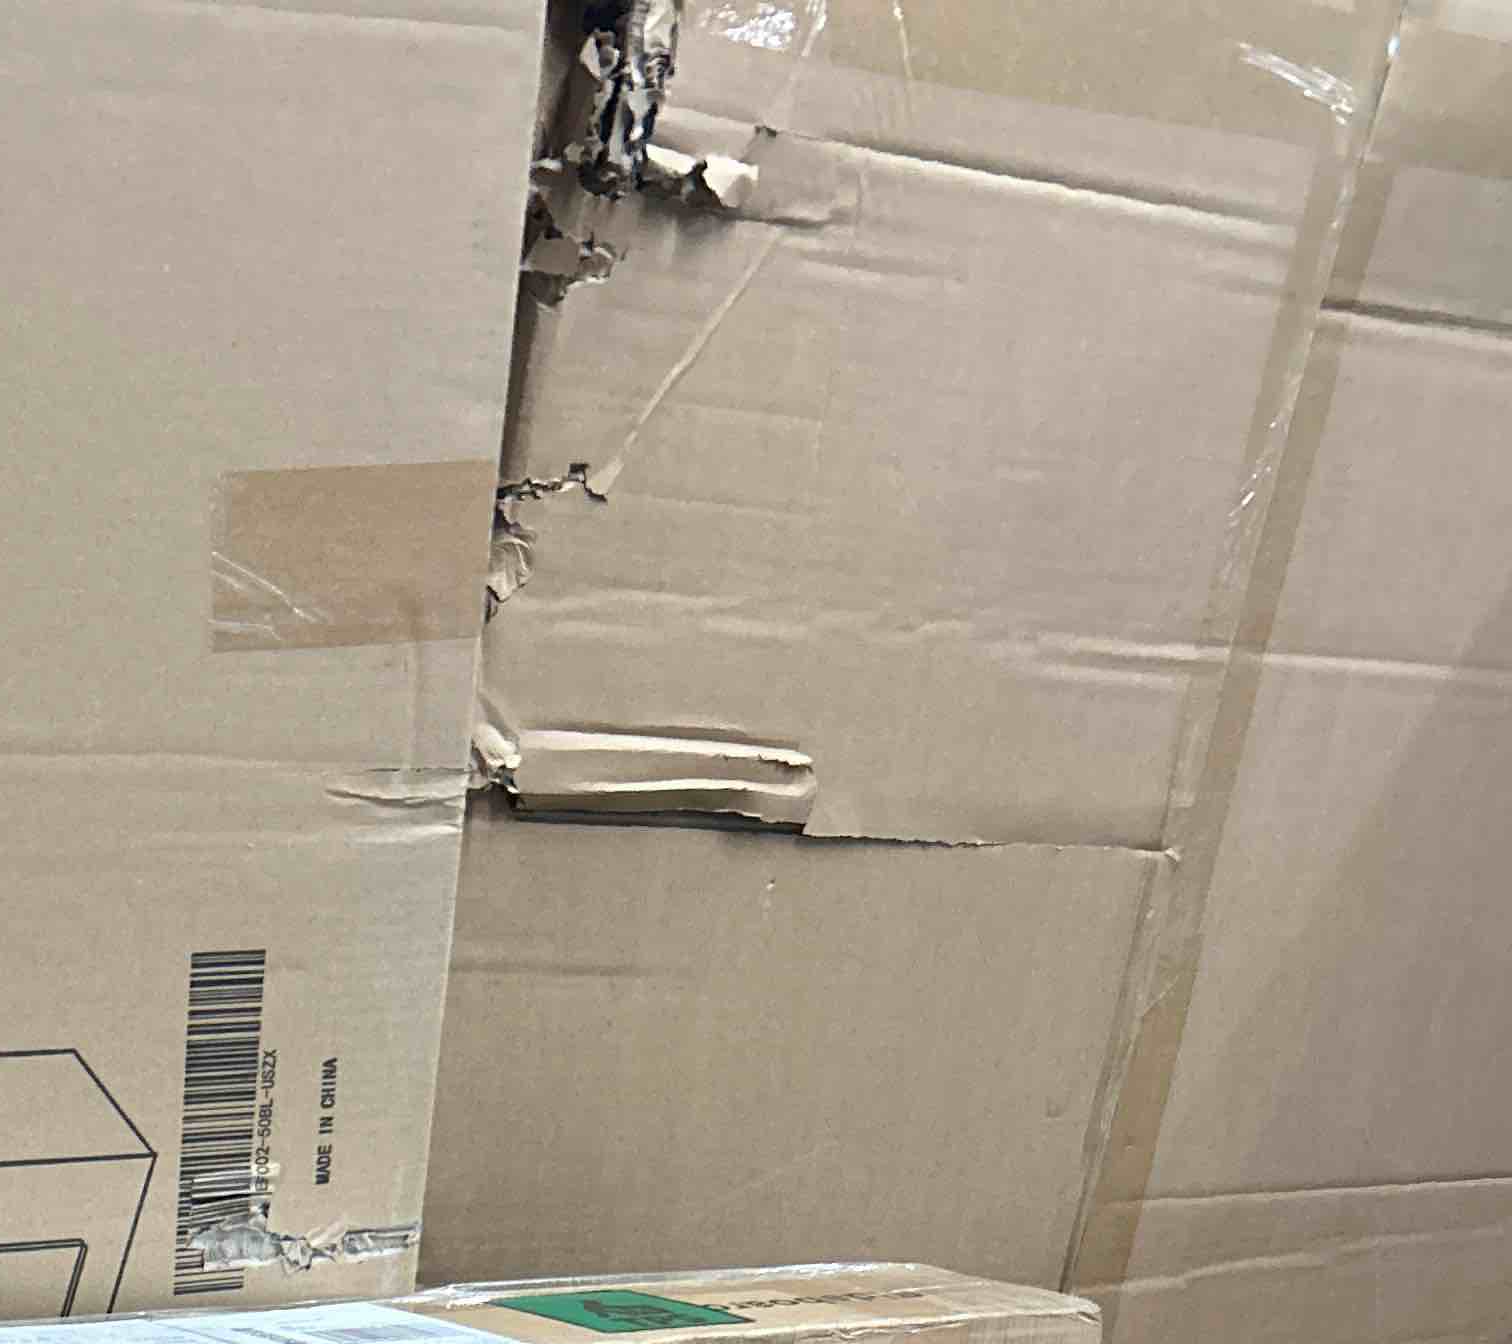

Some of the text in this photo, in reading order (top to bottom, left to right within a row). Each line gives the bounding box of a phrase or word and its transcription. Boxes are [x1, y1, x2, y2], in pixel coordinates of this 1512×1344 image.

[315, 1057, 337, 1185] MADE IN CHINA
